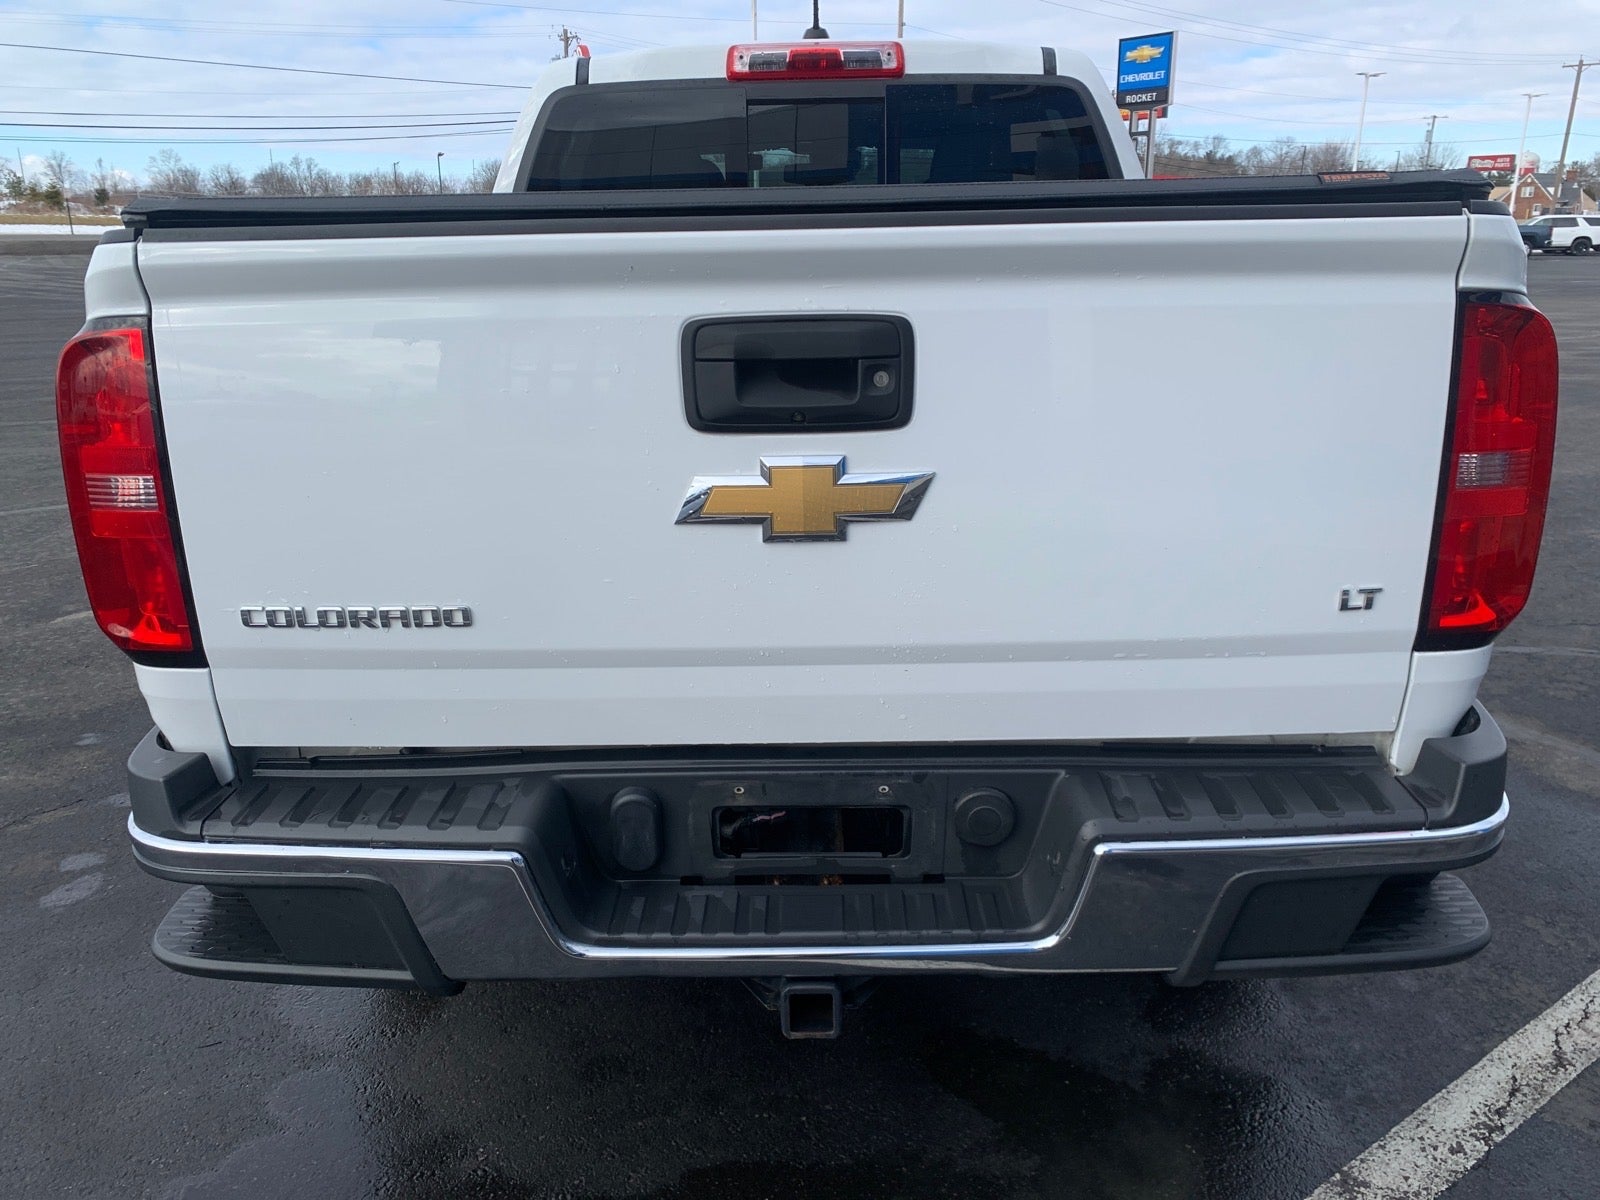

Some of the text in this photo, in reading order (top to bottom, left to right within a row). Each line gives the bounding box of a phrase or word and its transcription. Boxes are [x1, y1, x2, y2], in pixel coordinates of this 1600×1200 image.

[1120, 70, 1166, 84] CHEVROLET
[1126, 92, 1158, 104] ROCKET
[1339, 585, 1383, 611] LT
[240, 606, 472, 628] COLORADO
